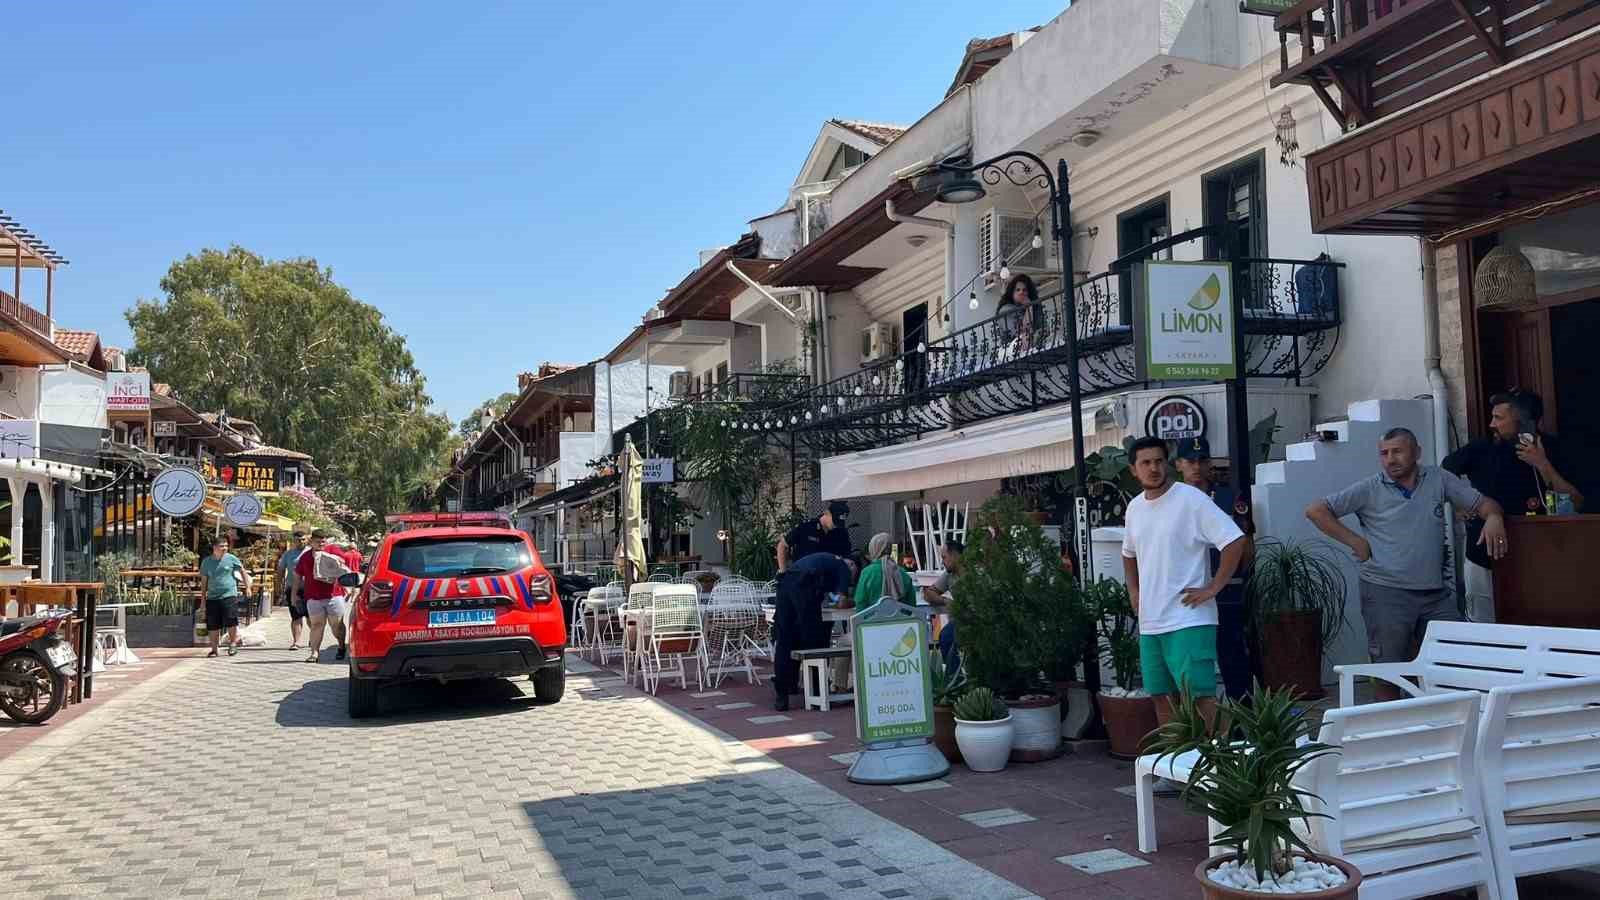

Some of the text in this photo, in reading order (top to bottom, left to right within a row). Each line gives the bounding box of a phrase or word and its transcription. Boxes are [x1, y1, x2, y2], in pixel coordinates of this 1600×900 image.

[1161, 308, 1222, 333] LİMON
[1157, 407, 1193, 439] poi
[869, 657, 920, 678] LİMON
